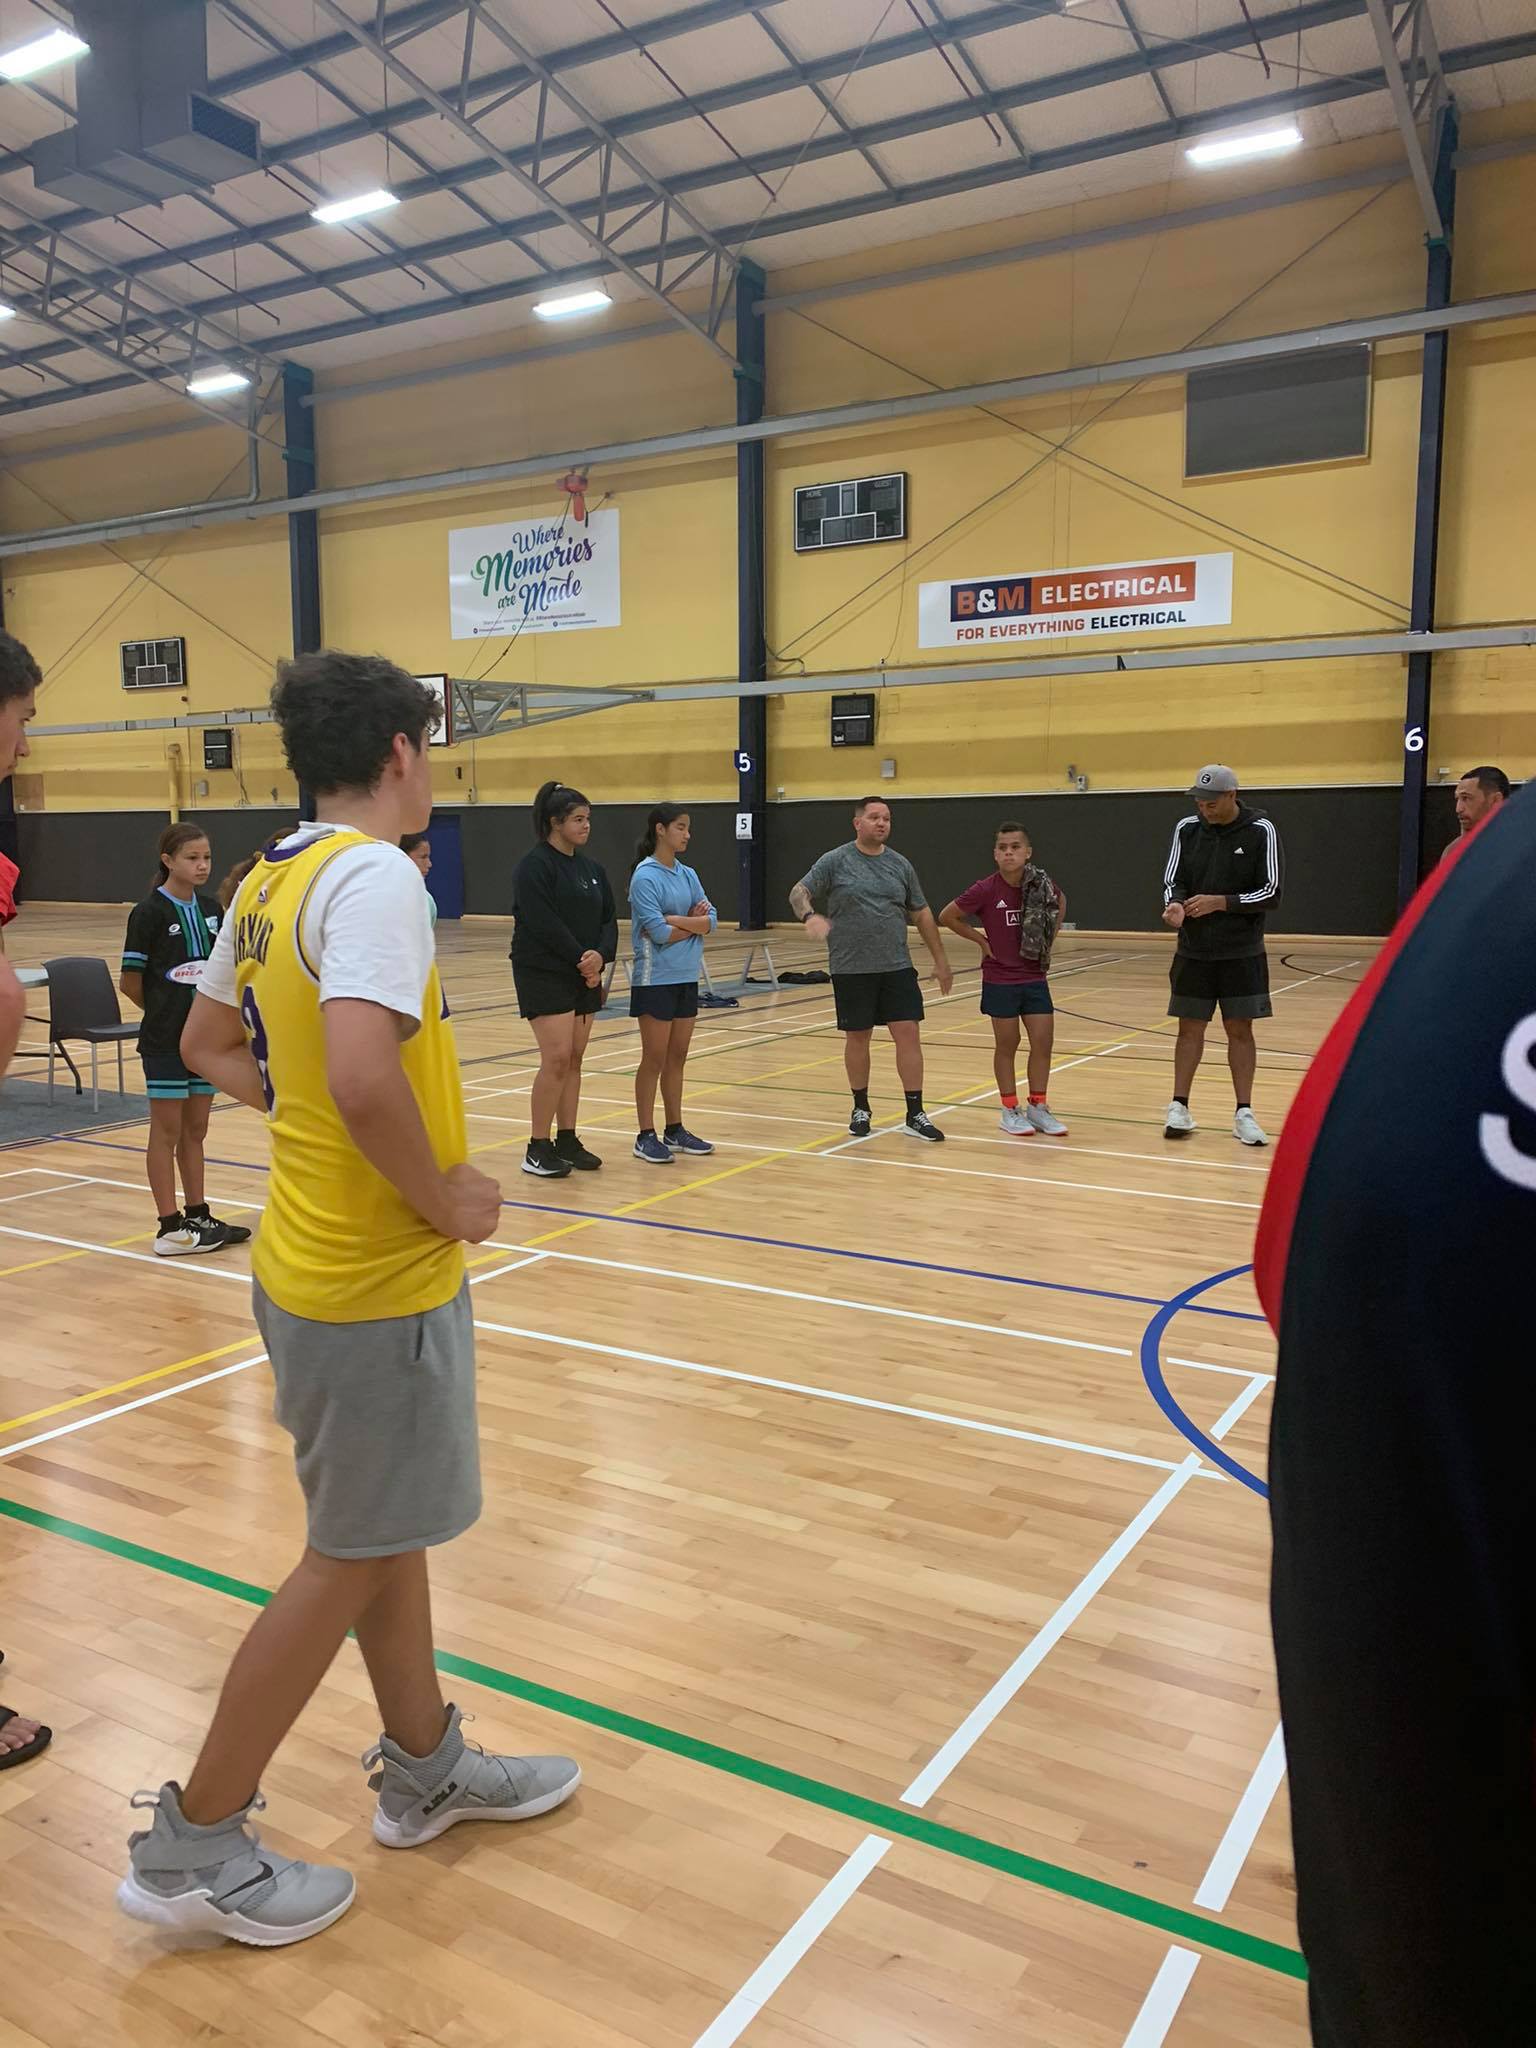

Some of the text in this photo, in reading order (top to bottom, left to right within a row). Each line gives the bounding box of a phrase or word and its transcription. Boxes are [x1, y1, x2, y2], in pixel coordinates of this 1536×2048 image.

[513, 525, 565, 554] Where
[471, 537, 597, 597] Memories
[498, 570, 583, 615] are Made
[957, 574, 1187, 615] B&M ELECTRICAL
[956, 610, 1187, 641] FOR EVERYTHING ELECTRICAL
[1404, 726, 1424, 751] 6
[738, 752, 751, 772] 5
[740, 818, 747, 830] 5
